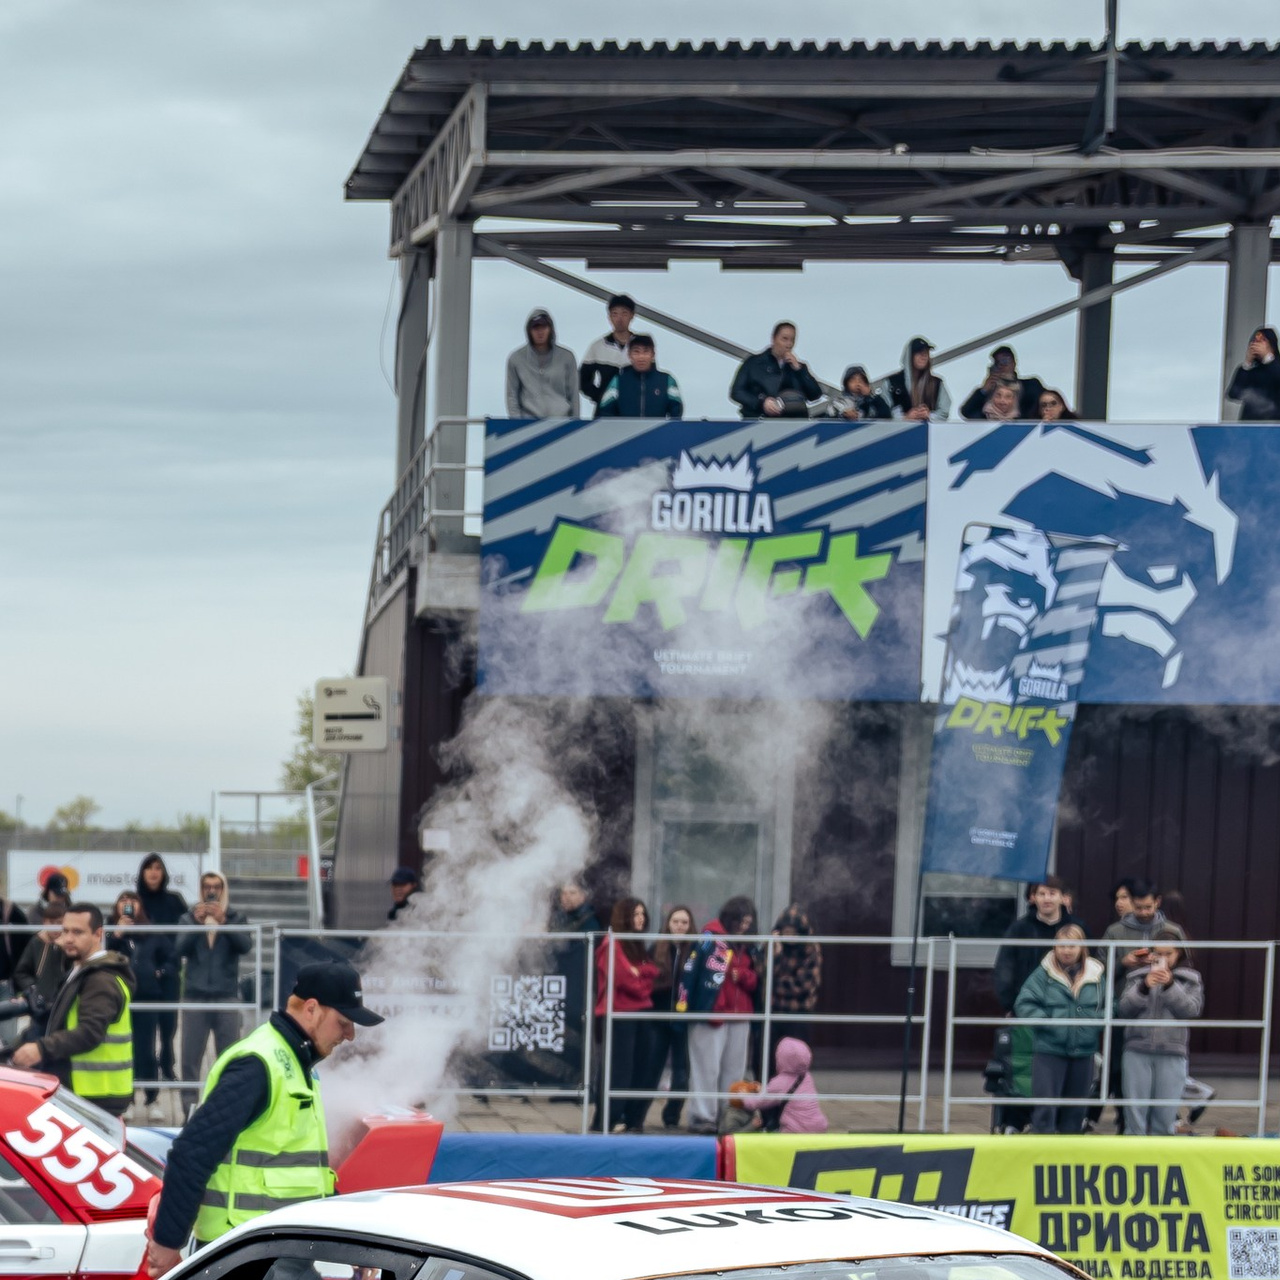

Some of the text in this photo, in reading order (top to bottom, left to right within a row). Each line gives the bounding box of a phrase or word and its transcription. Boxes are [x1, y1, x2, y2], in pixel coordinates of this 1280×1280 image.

[652, 493, 773, 532] GORILLA
[1018, 677, 1068, 700] GORILLA
[946, 698, 1068, 747] DRIFT
[5, 1101, 154, 1210] 555
[1034, 1165, 1190, 1206] ШКОЛА
[614, 1206, 936, 1236] LUKOIL
[1038, 1212, 1211, 1253] ДРИФТА
